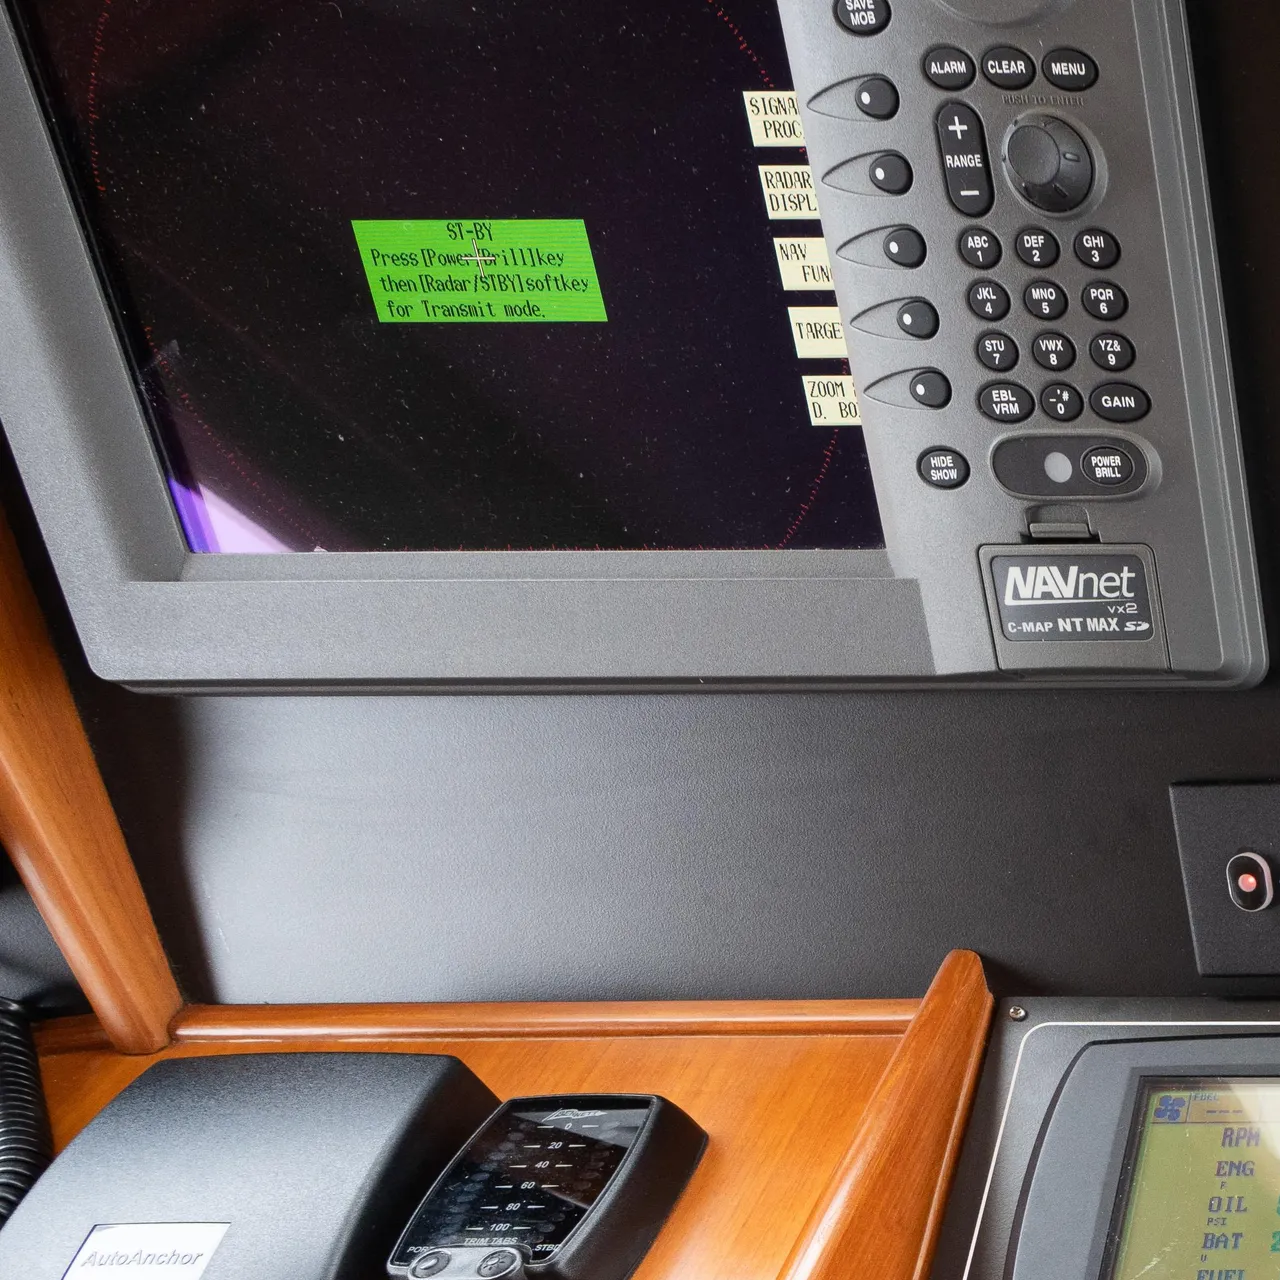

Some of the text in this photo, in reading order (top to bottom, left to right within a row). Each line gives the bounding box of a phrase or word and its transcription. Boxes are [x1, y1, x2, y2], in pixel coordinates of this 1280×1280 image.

[850, 10, 876, 26] MOB
[931, 61, 967, 74] ALARM
[988, 61, 1026, 75] CLEAR
[1051, 62, 1086, 76] MENU
[946, 155, 982, 168] RANGE
[764, 171, 812, 189] RADAR
[446, 222, 493, 241] ST-BY
[967, 236, 989, 248] ABC
[1023, 236, 1045, 248] DEF
[1083, 236, 1104, 248] GHI
[779, 244, 807, 261] NAV
[977, 251, 983, 262] 1
[1033, 250, 1041, 262] 2
[1092, 250, 1100, 262] 3
[976, 288, 997, 300] JKL
[1031, 288, 1056, 300] MNO
[1090, 289, 1114, 301] PQR
[386, 300, 546, 318] for Transmit mode.
[985, 303, 992, 314] 4
[1042, 302, 1050, 314] 5
[1100, 302, 1108, 314] 6
[985, 340, 1005, 352] STU
[1039, 340, 1064, 351] VWX
[1099, 340, 1121, 352] YZ&
[993, 354, 1000, 365] 7
[1049, 354, 1058, 365] 8
[1108, 354, 1116, 365] 9
[807, 381, 844, 398] ZOOM
[992, 390, 1017, 401] EBL
[1101, 396, 1135, 408] GAIN
[813, 402, 827, 419] D.
[993, 403, 1020, 415] VRM
[1057, 403, 1065, 414] 0
[930, 456, 954, 468] HIDE
[1091, 456, 1121, 467] POWER
[930, 469, 957, 481] SHOW
[1095, 467, 1121, 478] BRILL
[1005, 566, 1136, 601] NAVnet
[1007, 618, 1120, 633] C-MAP NT MAX
[565, 1122, 572, 1130] 0
[1222, 1127, 1261, 1147] RPM
[548, 1141, 563, 1149] 20
[535, 1161, 549, 1169] 40
[1215, 1160, 1256, 1177] ENG
[1220, 1181, 1227, 1189] F
[506, 1203, 521, 1211] 80
[1208, 1195, 1248, 1213] OIL
[489, 1223, 512, 1231] 100
[1207, 1217, 1227, 1226] PSI
[464, 1237, 518, 1245] TRIM TABS
[1202, 1232, 1243, 1250] BAT
[80, 1249, 204, 1267] AutoAnchor
